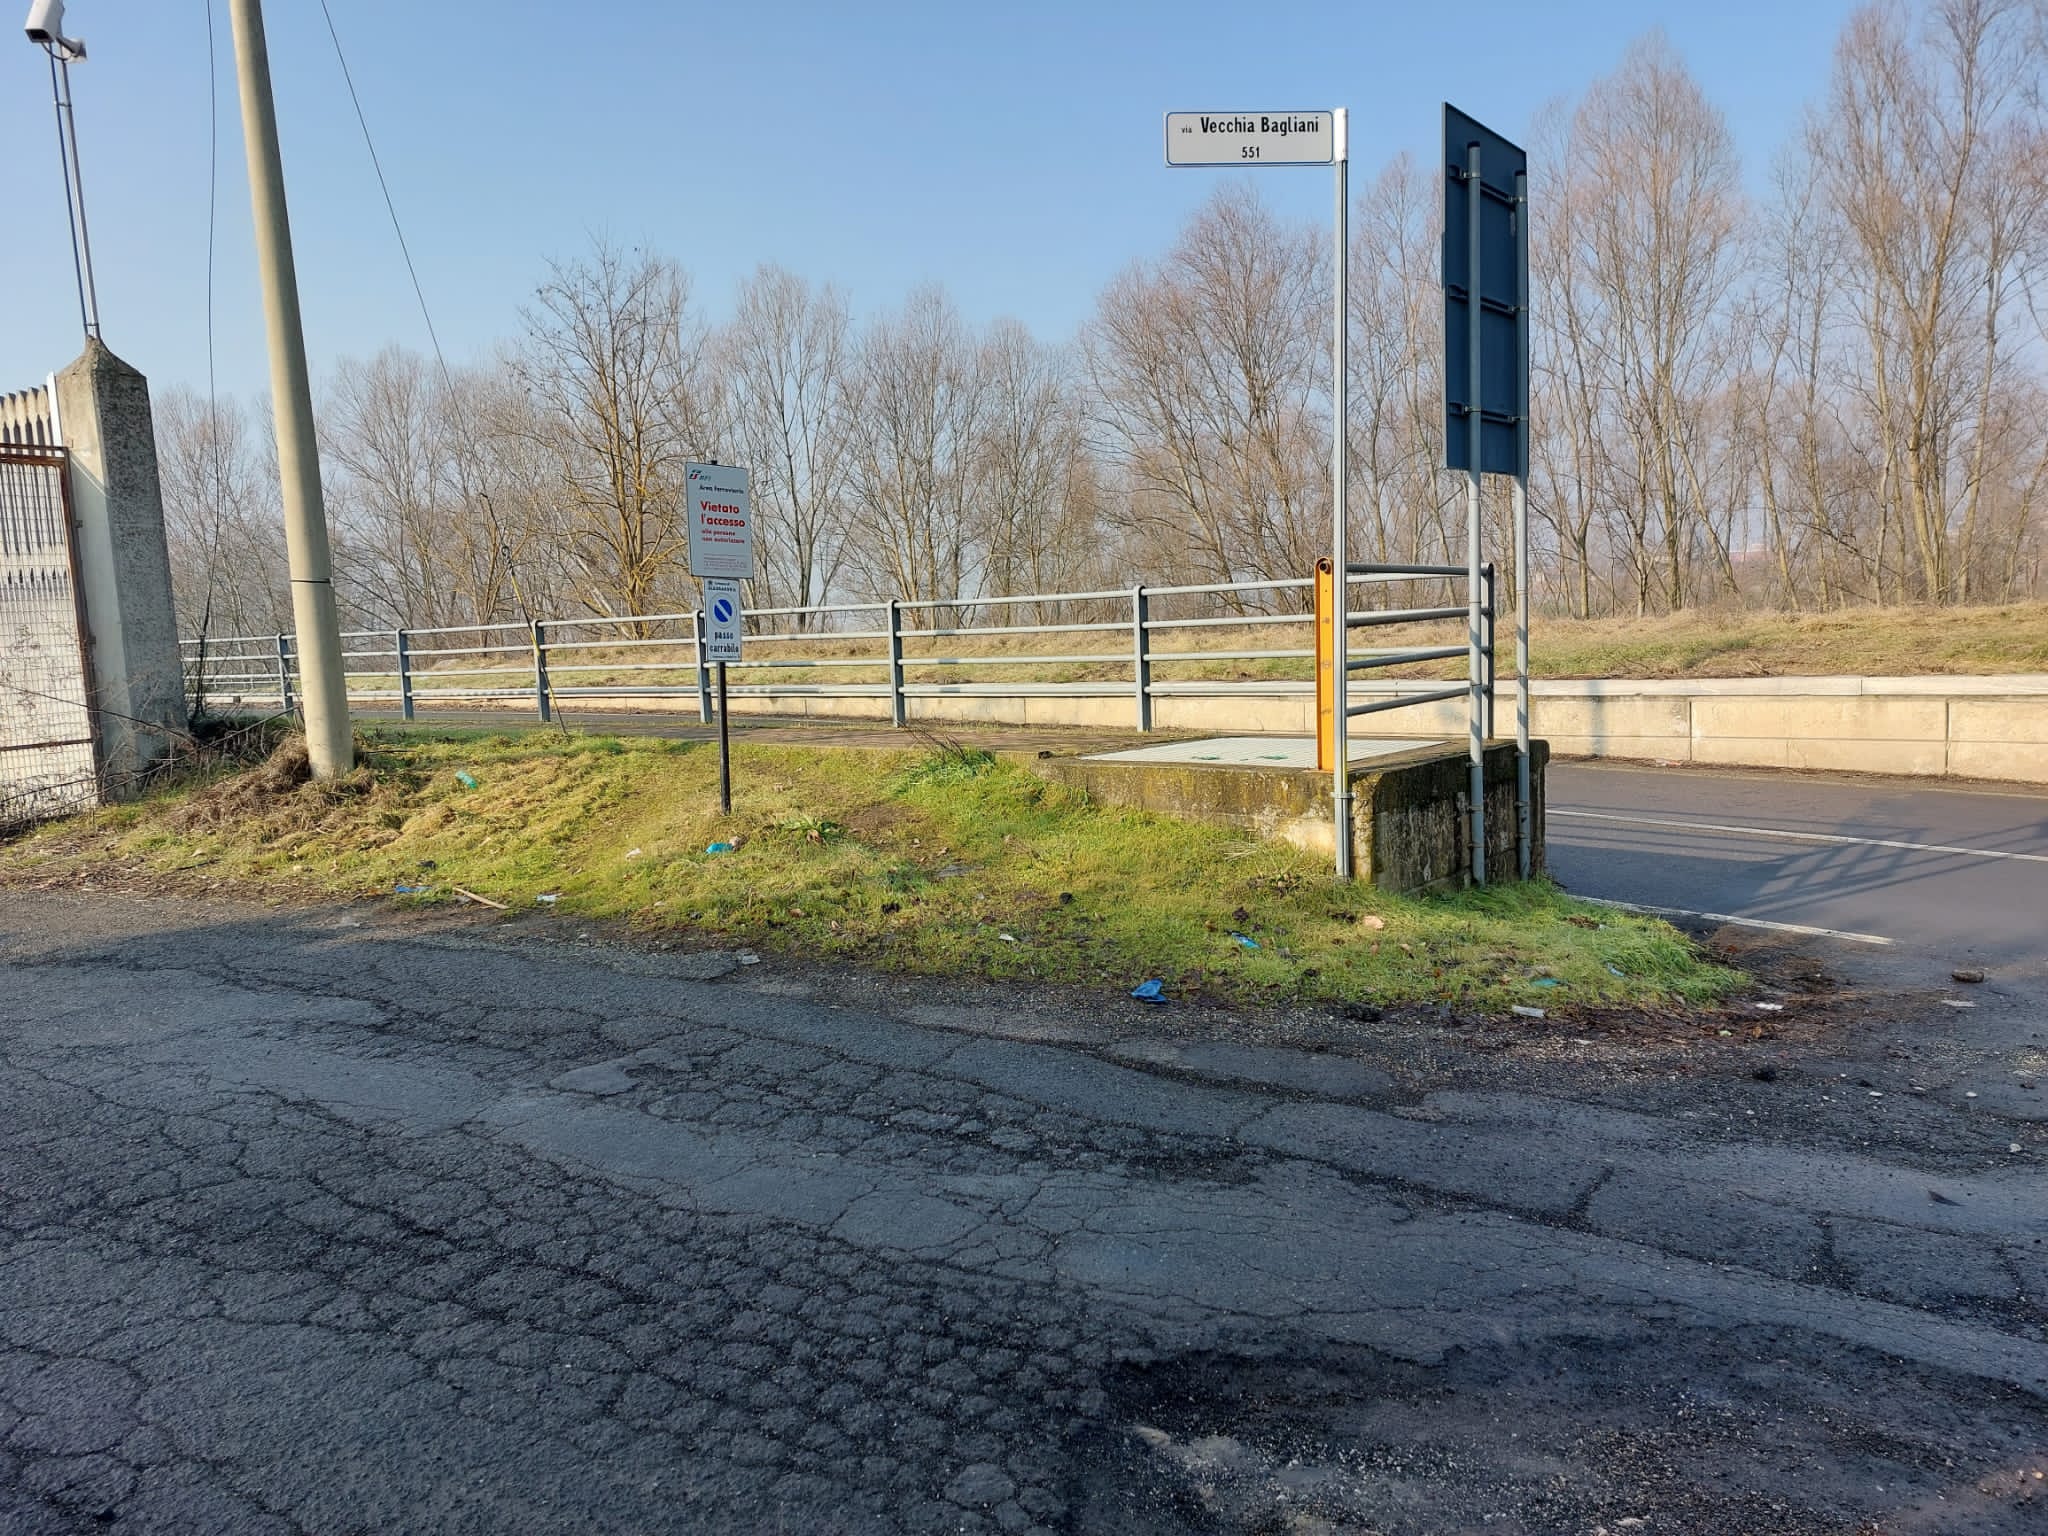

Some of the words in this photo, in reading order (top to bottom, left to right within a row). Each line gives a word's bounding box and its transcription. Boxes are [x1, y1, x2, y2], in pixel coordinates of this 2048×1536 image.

[1181, 124, 1193, 134] via
[1200, 116, 1255, 134] Vecchia
[1261, 116, 1319, 137] Bagliani
[1241, 146, 1260, 159] 551
[700, 500, 740, 514] Vietato
[700, 513, 746, 527] l'accesso
[714, 631, 734, 642] passo
[709, 643, 739, 653] carrabile
